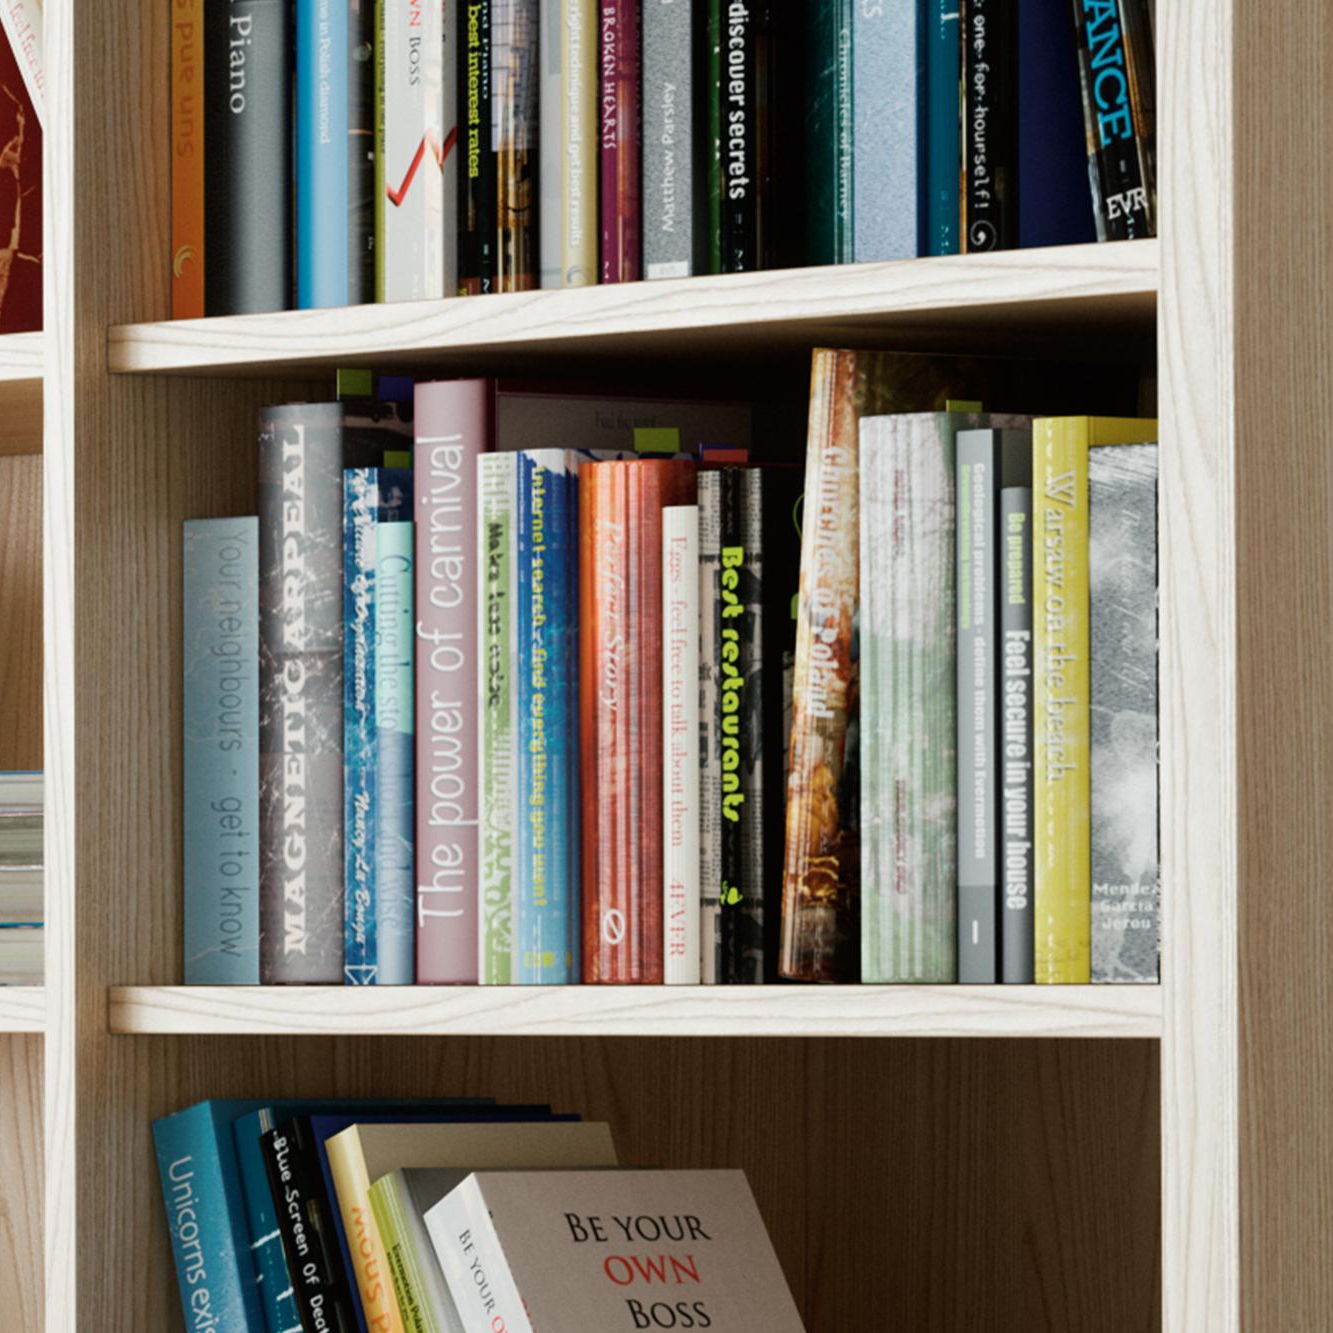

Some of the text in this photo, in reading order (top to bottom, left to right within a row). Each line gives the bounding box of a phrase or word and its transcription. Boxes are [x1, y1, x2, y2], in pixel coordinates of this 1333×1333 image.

[228, 13, 252, 114] Piano
[407, 36, 422, 86] BOSS
[602, 6, 617, 150] BROKEN HEARTS
[727, 2, 750, 200] discover secrets
[660, 82, 676, 232] Matthew Parsley
[1106, 187, 1149, 221] EVR
[1004, 512, 1026, 606] Be prepared
[211, 529, 250, 955] Your neighbours get to know
[415, 433, 473, 927] The power of carnival
[722, 545, 744, 823] Best restaurants
[284, 660, 307, 957] MAGNETIC
[1003, 630, 1031, 912] Feel secure in your house
[169, 1154, 207, 1286] Unicorns
[273, 1131, 291, 1182] Blue
[285, 1187, 309, 1258] Screen
[301, 1263, 319, 1285] Of
[459, 1229, 476, 1256] BE
[469, 1257, 496, 1314] YOUR
[564, 1213, 712, 1243] BE YOUR
[604, 1254, 701, 1286] OWN
[625, 1299, 712, 1329] BOSS
